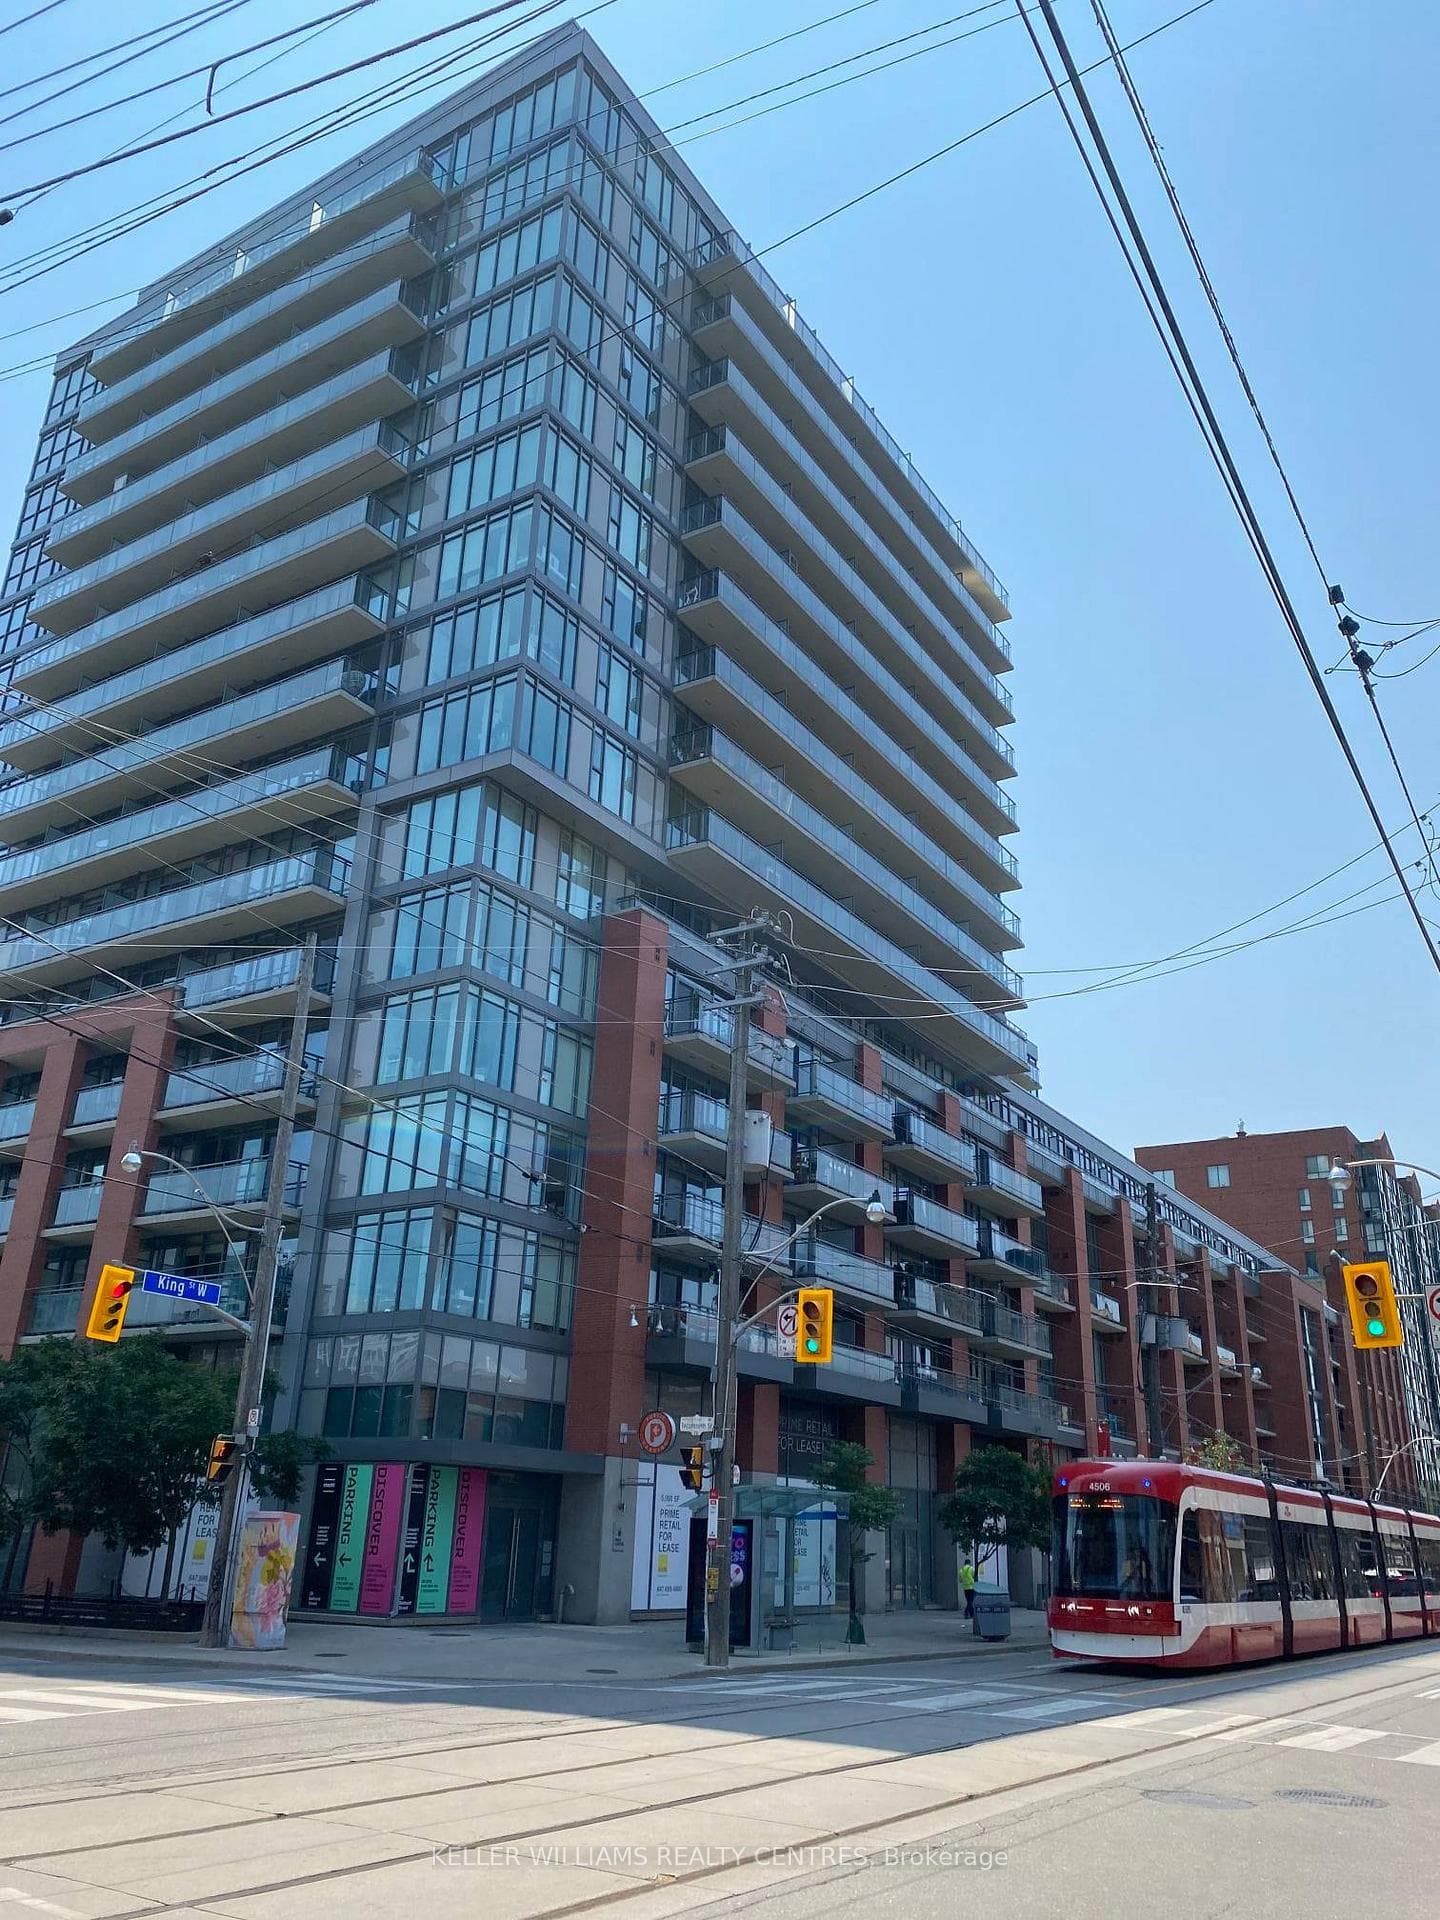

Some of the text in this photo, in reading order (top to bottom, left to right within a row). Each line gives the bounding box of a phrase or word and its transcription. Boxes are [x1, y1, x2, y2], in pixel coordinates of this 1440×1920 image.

[158, 1275, 208, 1297] King St W
[1089, 1482, 1111, 1491] 4506
[340, 1467, 359, 1545] PARKING
[368, 1467, 388, 1556] DISCOVER
[424, 1469, 441, 1547] PARKING
[197, 1514, 215, 1525] FOR
[454, 1471, 472, 1558] DISCOVER
[659, 1509, 680, 1519] PRIME
[659, 1520, 682, 1531] RETAIL
[195, 1527, 218, 1538] LEAS
[659, 1531, 673, 1542] FOR
[658, 1543, 680, 1553] LEASE
